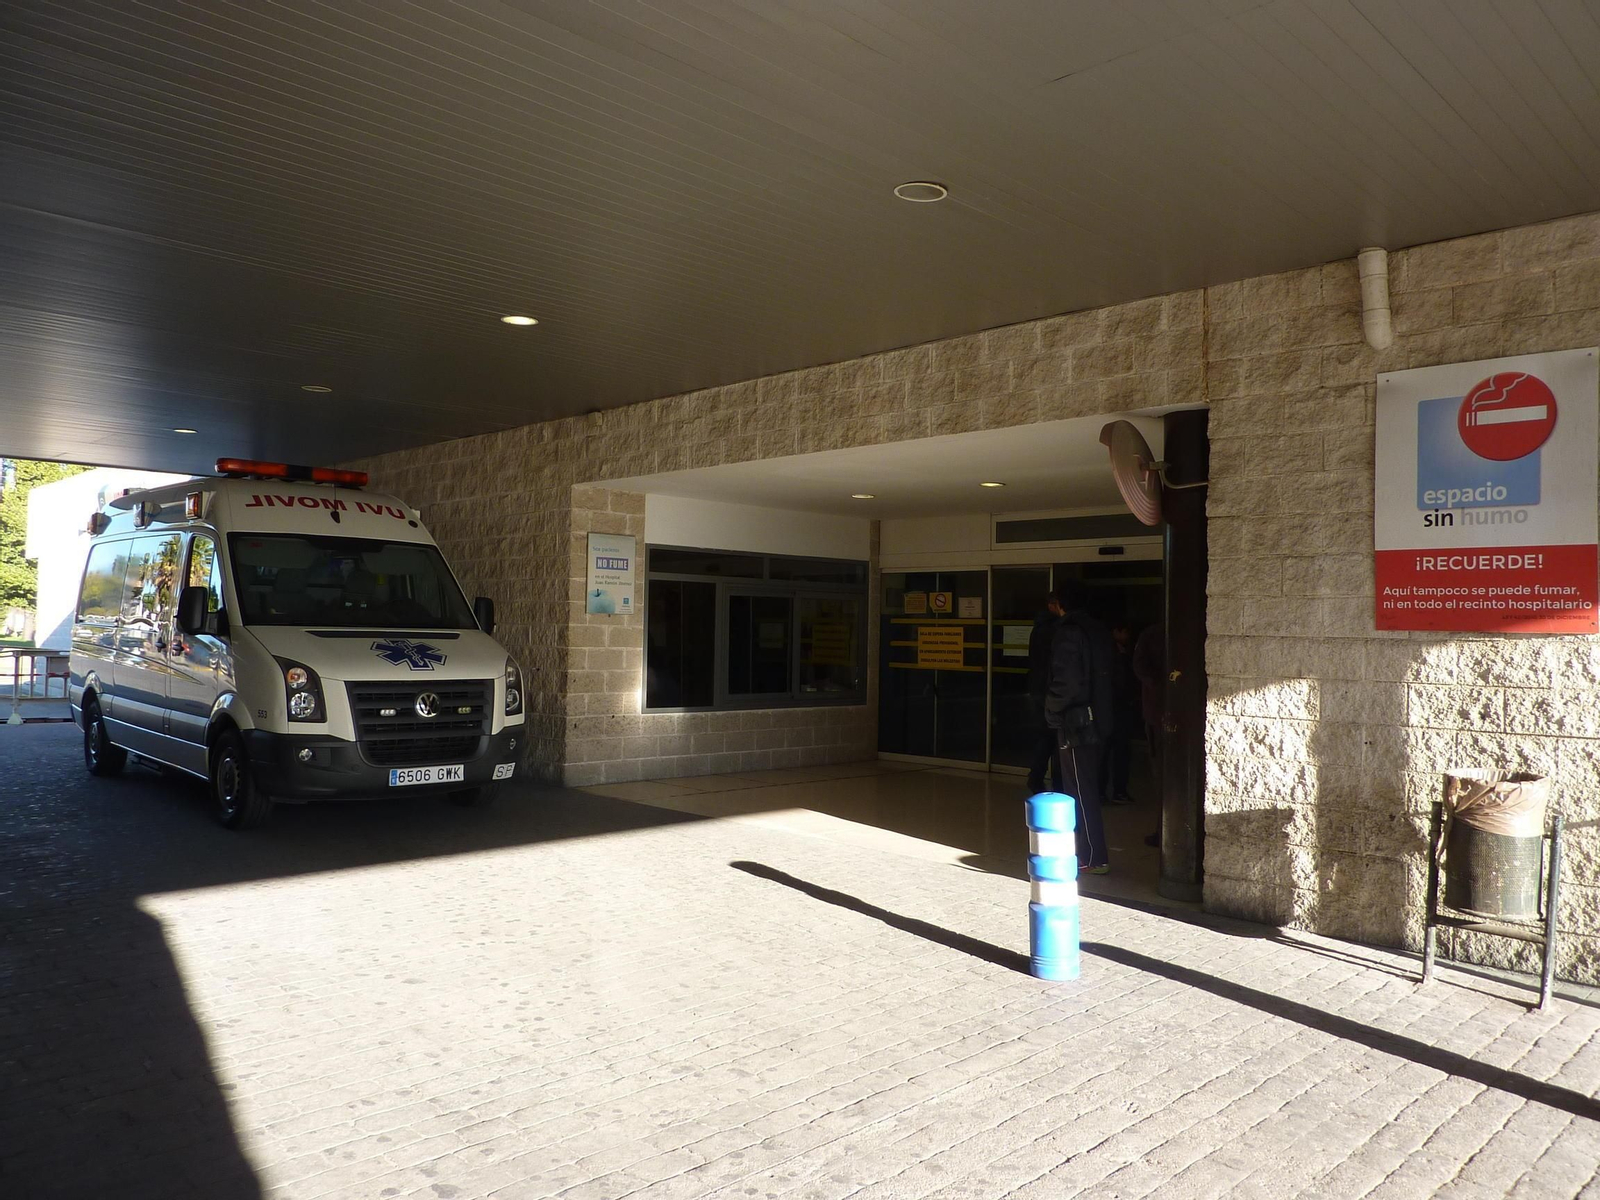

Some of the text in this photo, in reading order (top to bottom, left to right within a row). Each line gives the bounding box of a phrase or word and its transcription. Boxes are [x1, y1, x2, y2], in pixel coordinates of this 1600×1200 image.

[1423, 482, 1508, 508] espacio
[1423, 507, 1529, 528] sin humo
[597, 558, 628, 569] NO FUME
[1416, 554, 1544, 571] ¡RECUERDE!
[1383, 584, 1580, 598] Aquí tampoco se puede fumar,
[1383, 599, 1593, 611] ni en todo el recinto hospitalario
[398, 766, 461, 783] 6506 GWK
